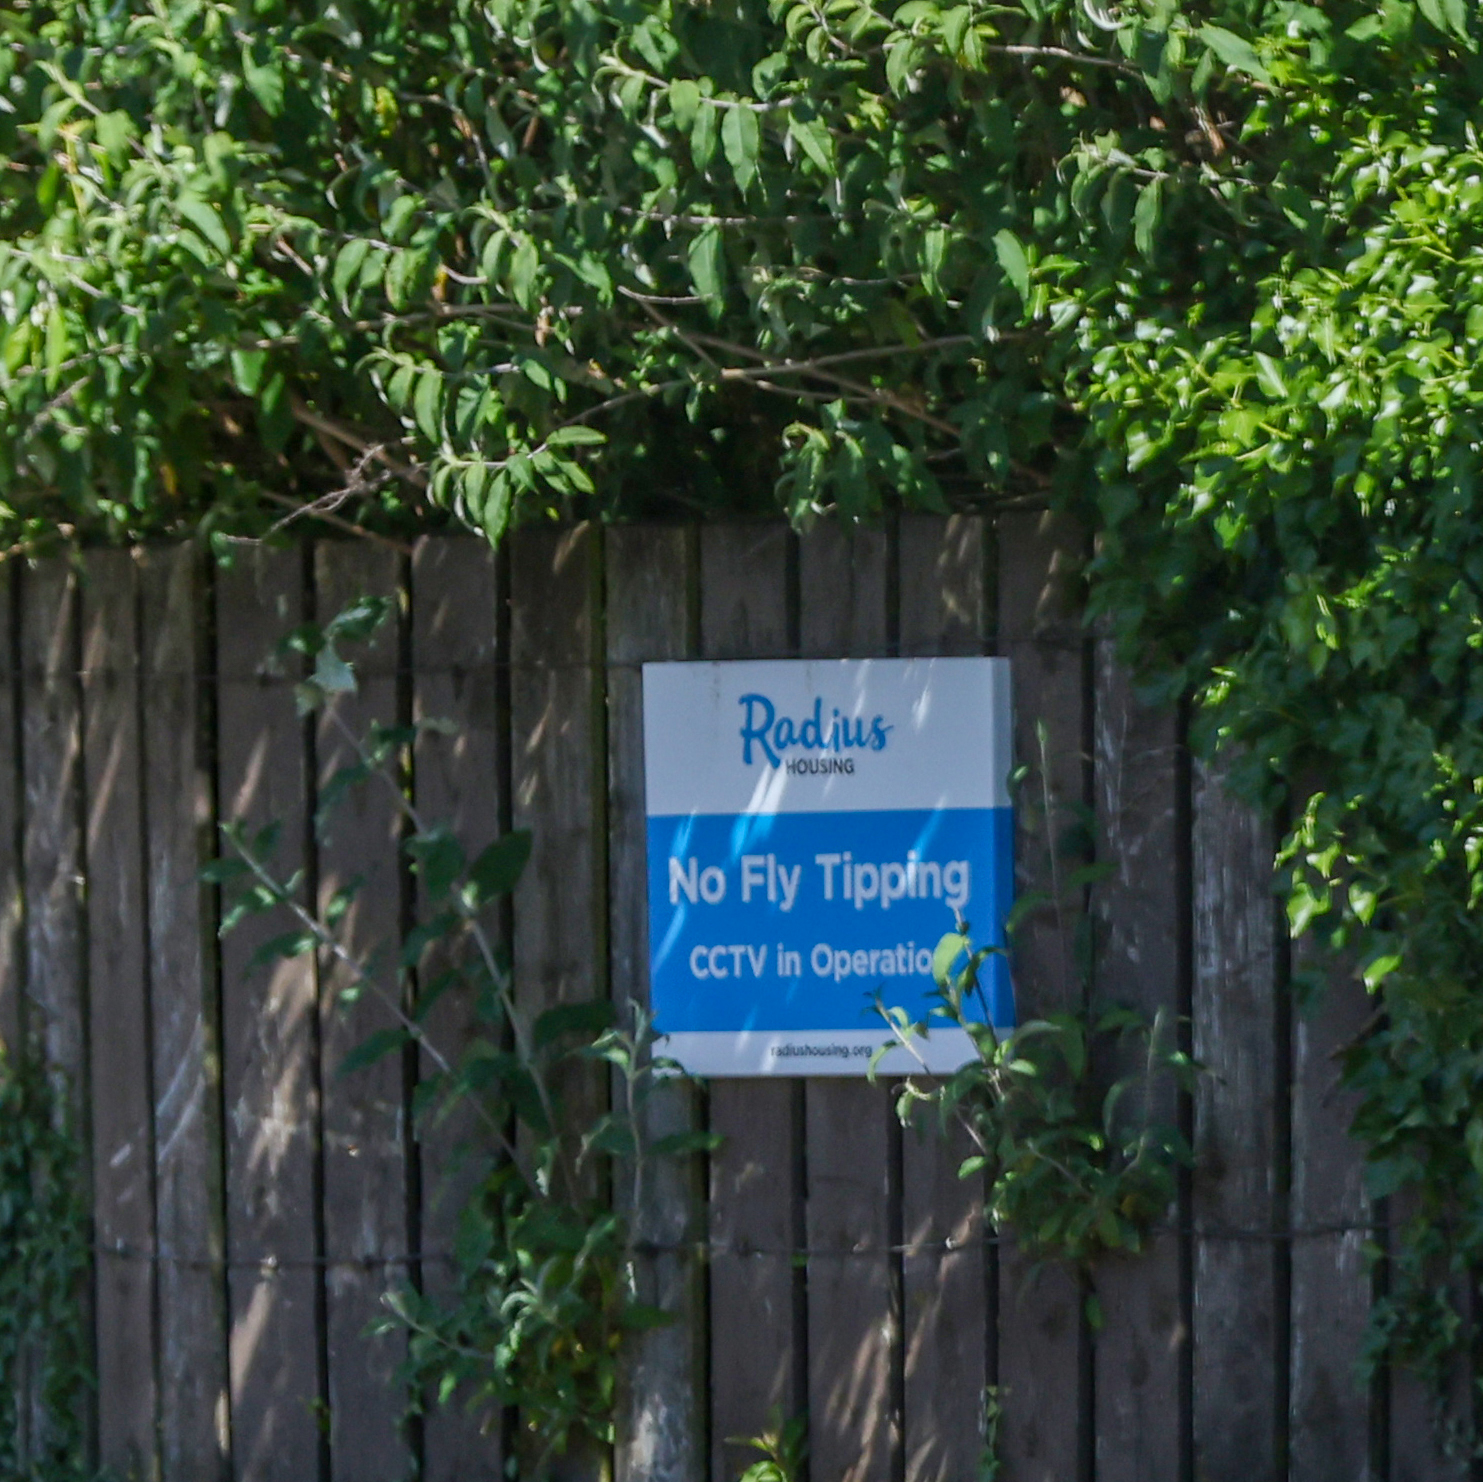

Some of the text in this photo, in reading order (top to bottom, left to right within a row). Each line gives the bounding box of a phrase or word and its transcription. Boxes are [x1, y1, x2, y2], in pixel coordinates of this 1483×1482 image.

[738, 694, 894, 768] Radius
[786, 757, 855, 775] HOUSING
[668, 851, 971, 911] No Fly Tipping
[690, 942, 935, 982] CCTV in Operatio
[770, 1043, 873, 1060] radiushousing.org
